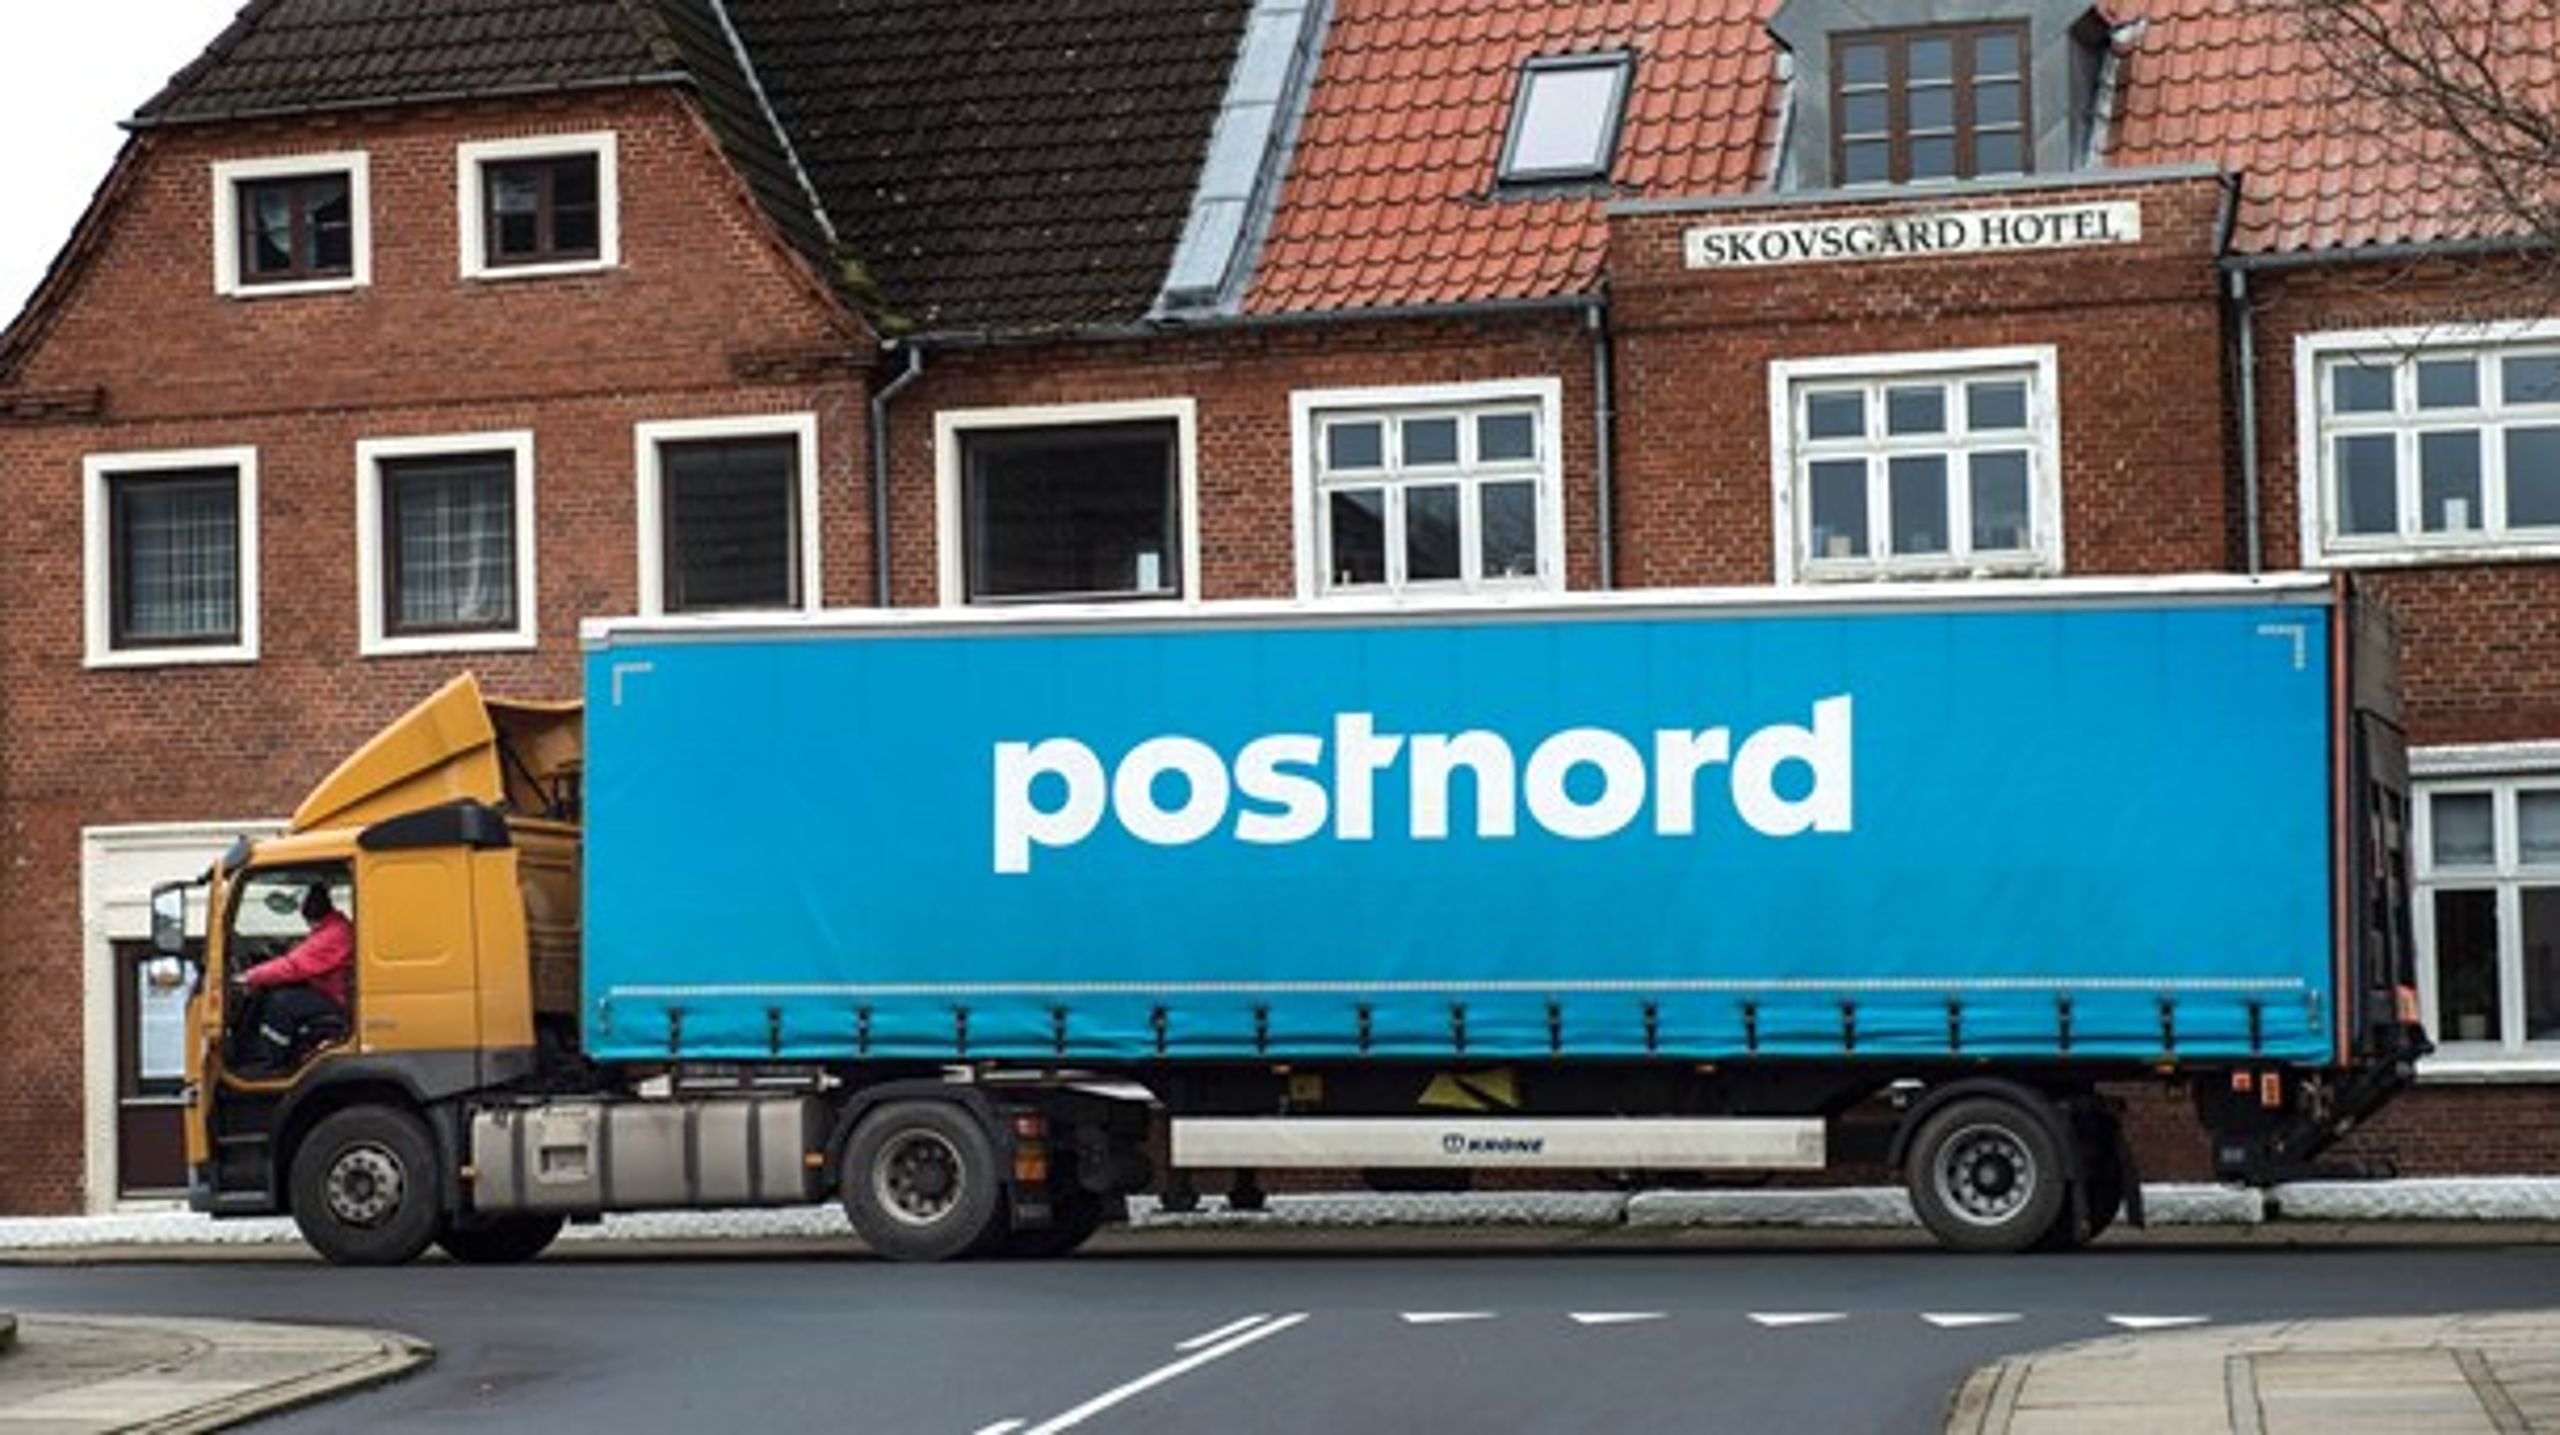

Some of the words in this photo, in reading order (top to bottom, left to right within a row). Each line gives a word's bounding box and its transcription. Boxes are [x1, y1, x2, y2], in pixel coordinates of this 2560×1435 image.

[1980, 209, 2120, 244] HOTEL
[994, 694, 1853, 873] postnord
[1467, 1137, 1544, 1153] KRONE
